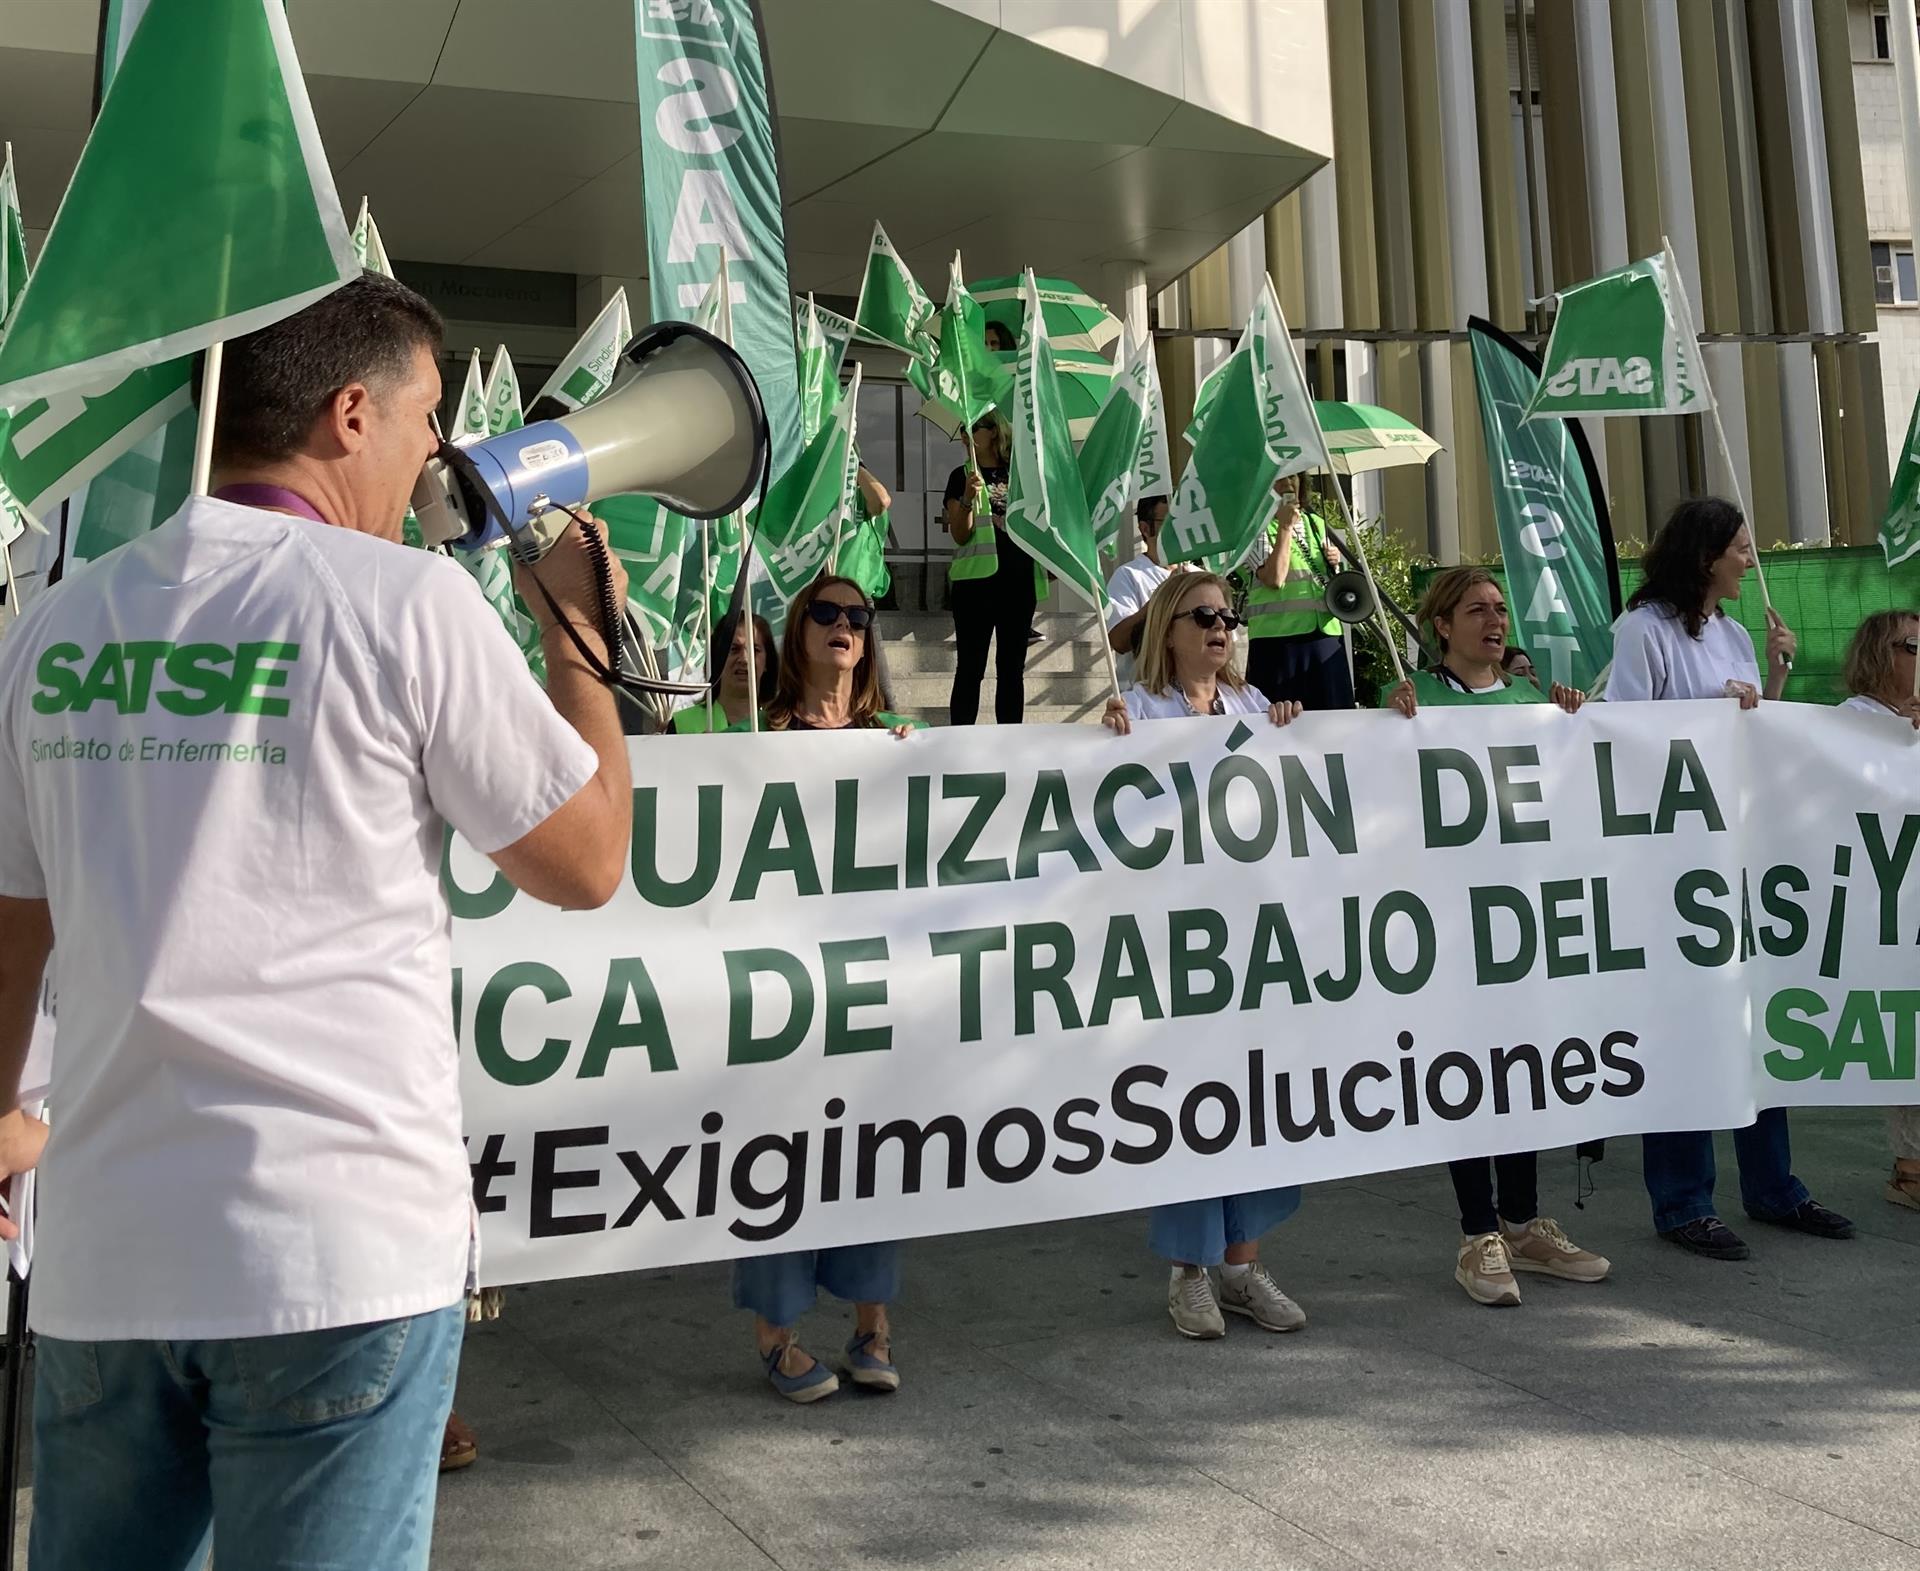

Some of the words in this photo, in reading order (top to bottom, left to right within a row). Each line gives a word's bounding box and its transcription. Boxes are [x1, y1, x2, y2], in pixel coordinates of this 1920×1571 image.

[31, 640, 301, 719] SATSE
[118, 738, 135, 762] de
[140, 736, 287, 765] Enfermería
[1417, 744, 1551, 849] DE
[1593, 738, 1727, 838] LA
[722, 936, 893, 1067] DE
[928, 889, 1437, 1043] TRABAJO
[1468, 876, 1646, 986] DEL
[1673, 864, 1810, 968] SAS
[1818, 812, 1920, 980] ¡Y
[461, 1030, 1646, 1243] #ExigimosSoluciones
